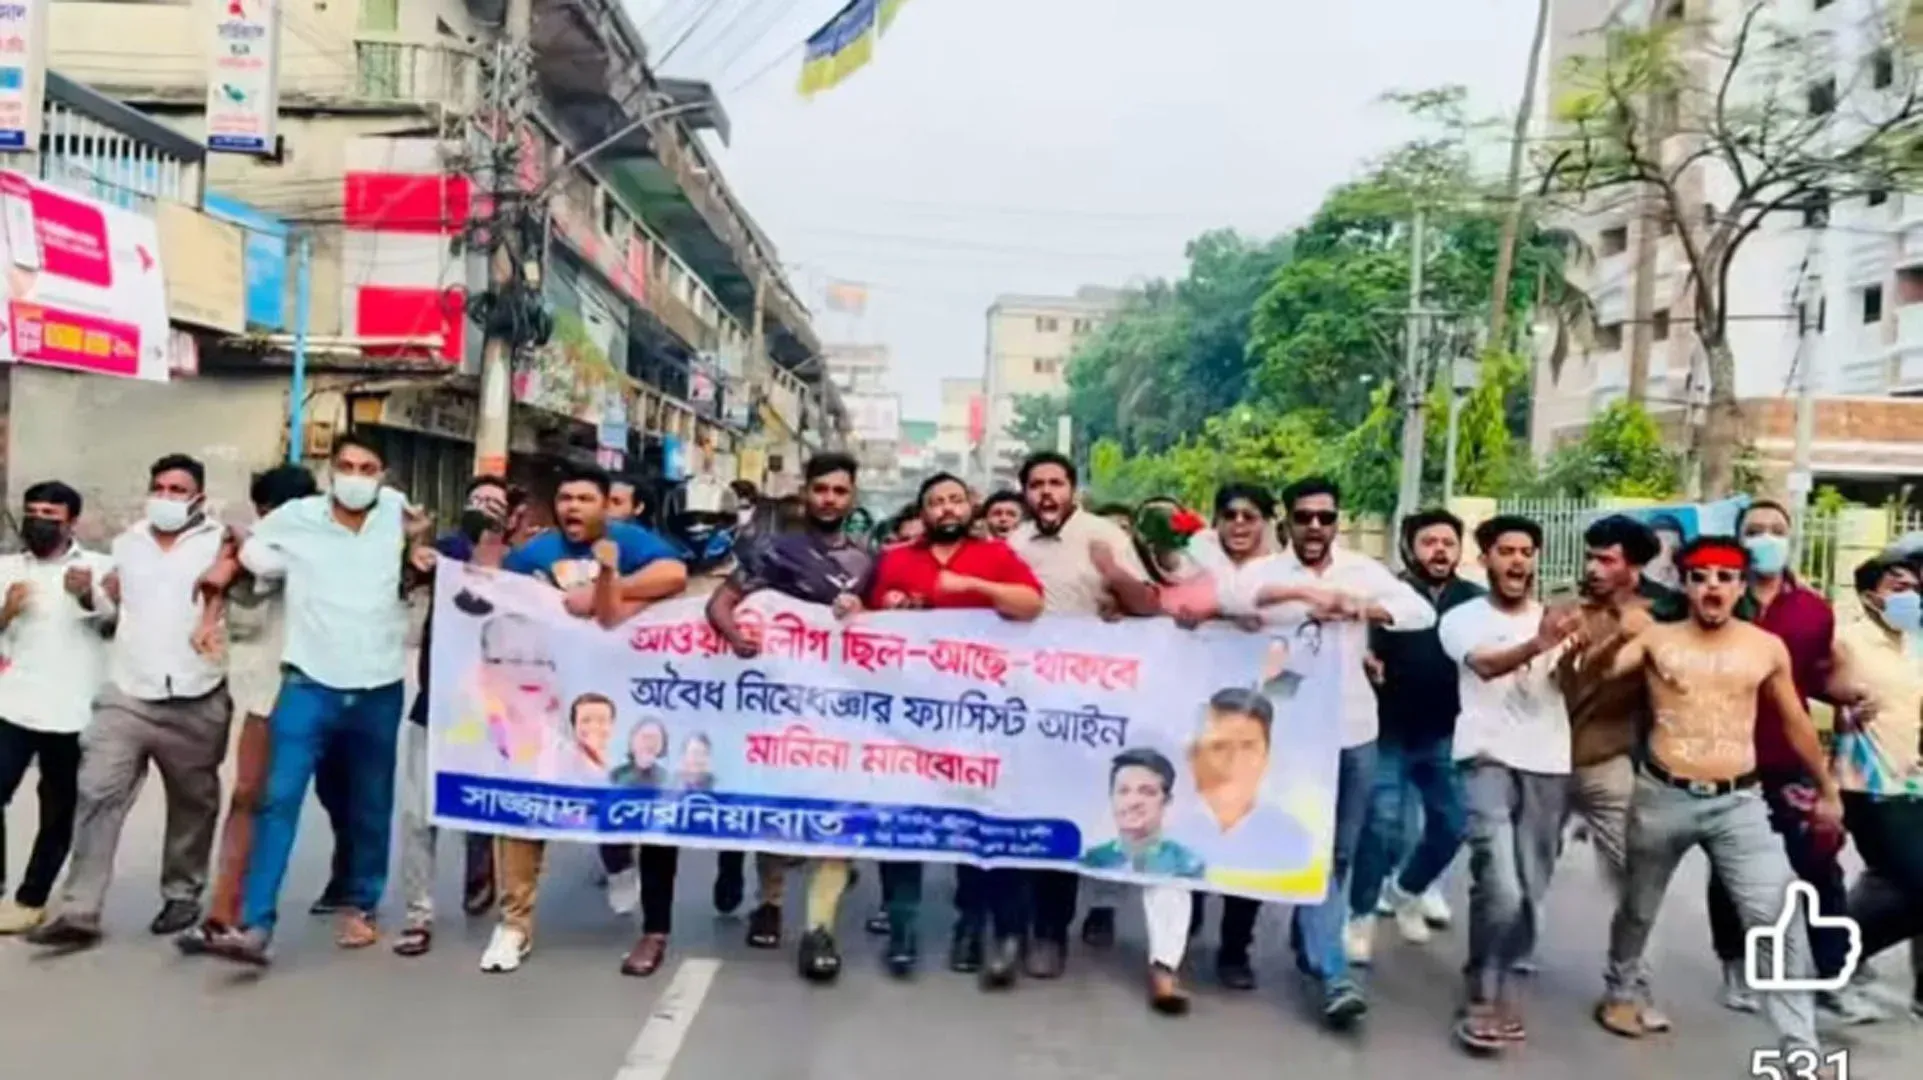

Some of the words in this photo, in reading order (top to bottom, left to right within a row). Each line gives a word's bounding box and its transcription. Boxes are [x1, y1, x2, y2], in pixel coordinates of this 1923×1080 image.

[630, 660, 727, 711] অবৈধ
[901, 689, 1029, 736] ফ্যাসিস্ট
[1036, 704, 1130, 748] আইন
[745, 724, 850, 774] মানিনা
[861, 743, 1000, 789] মানবোনা
[608, 794, 844, 839] সেরনিয়াবাত
